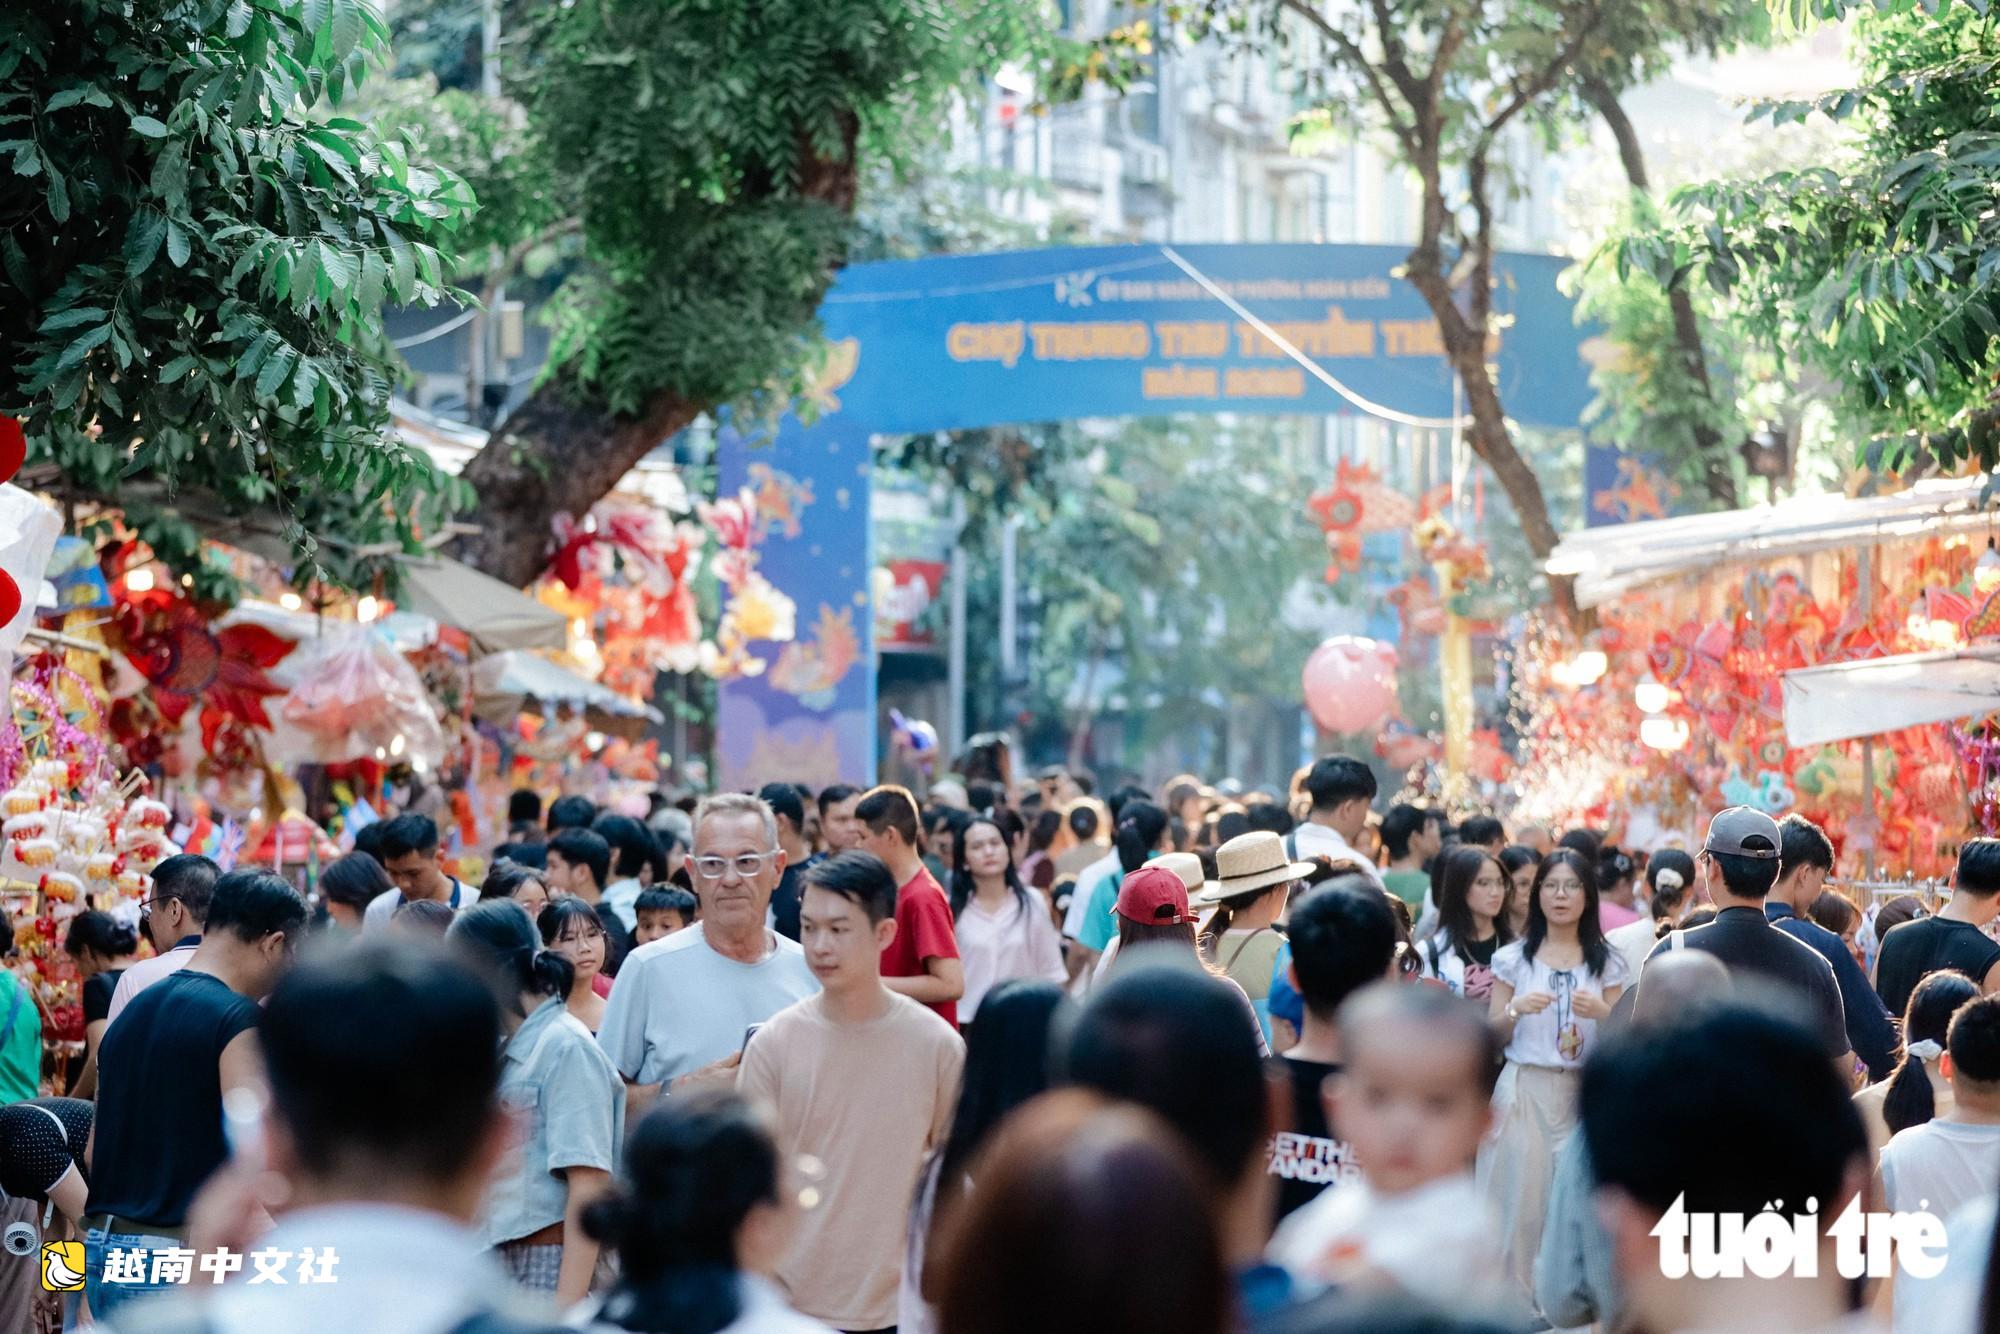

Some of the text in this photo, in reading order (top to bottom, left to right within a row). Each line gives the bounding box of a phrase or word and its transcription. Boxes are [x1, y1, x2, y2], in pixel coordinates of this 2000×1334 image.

[946, 320, 1025, 368] CHỢ
[1028, 321, 1149, 361] TRUNG
[1154, 321, 1229, 359] THU
